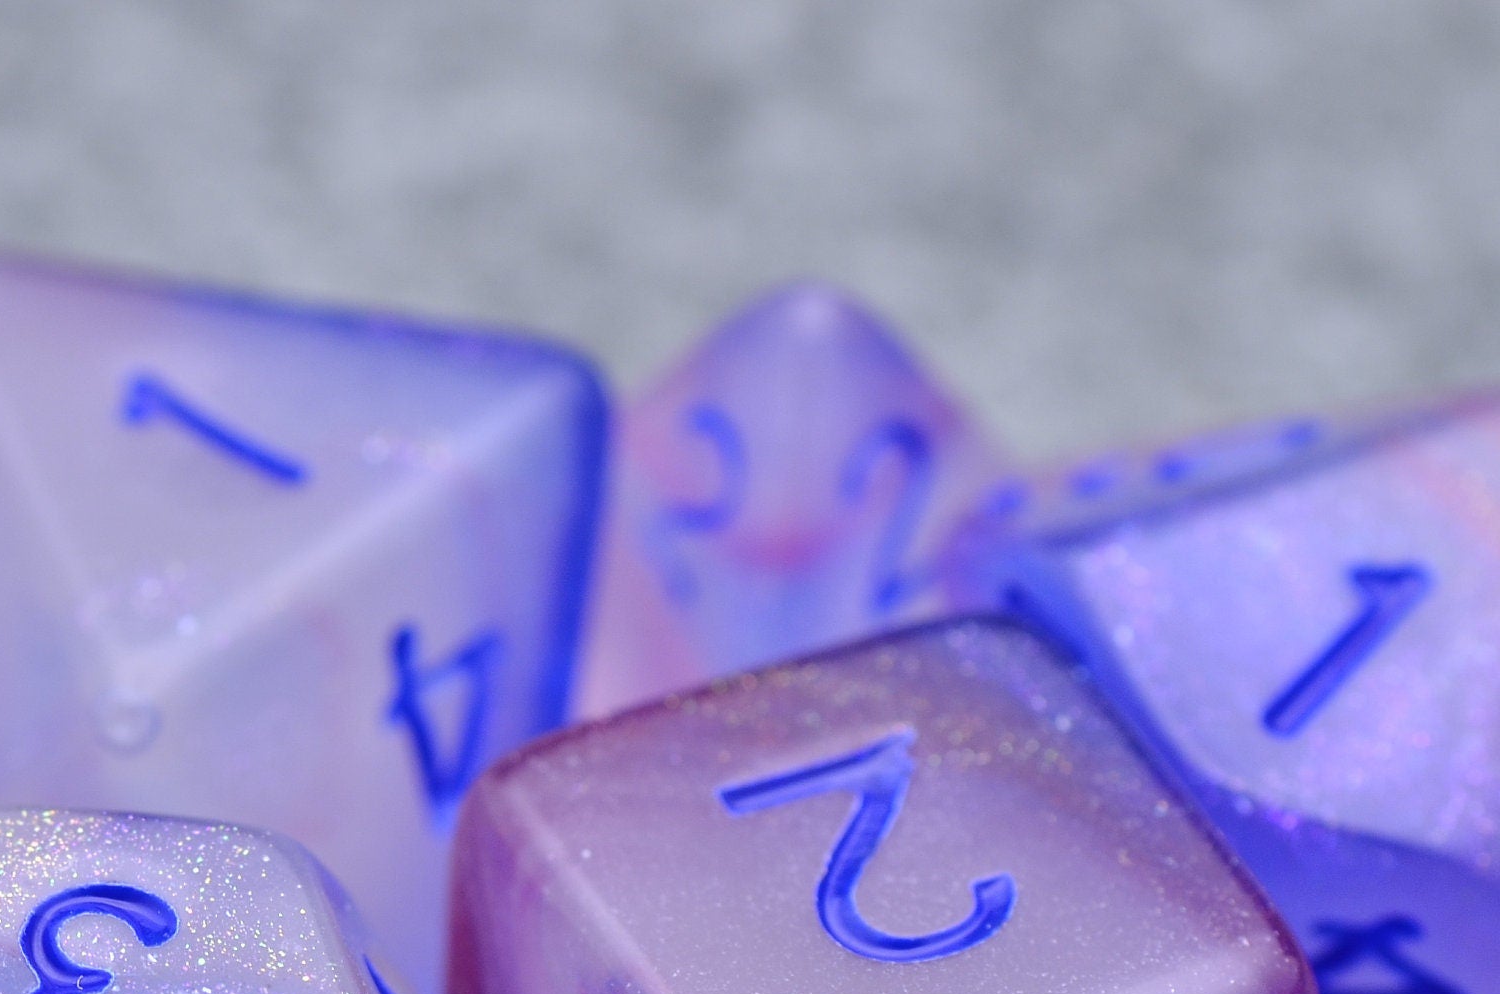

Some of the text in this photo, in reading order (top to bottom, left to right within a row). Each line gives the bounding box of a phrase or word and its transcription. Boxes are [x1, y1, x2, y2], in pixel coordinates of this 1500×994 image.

[386, 620, 508, 838] 4
[1258, 558, 1432, 740] 1
[714, 722, 1018, 966] 2
